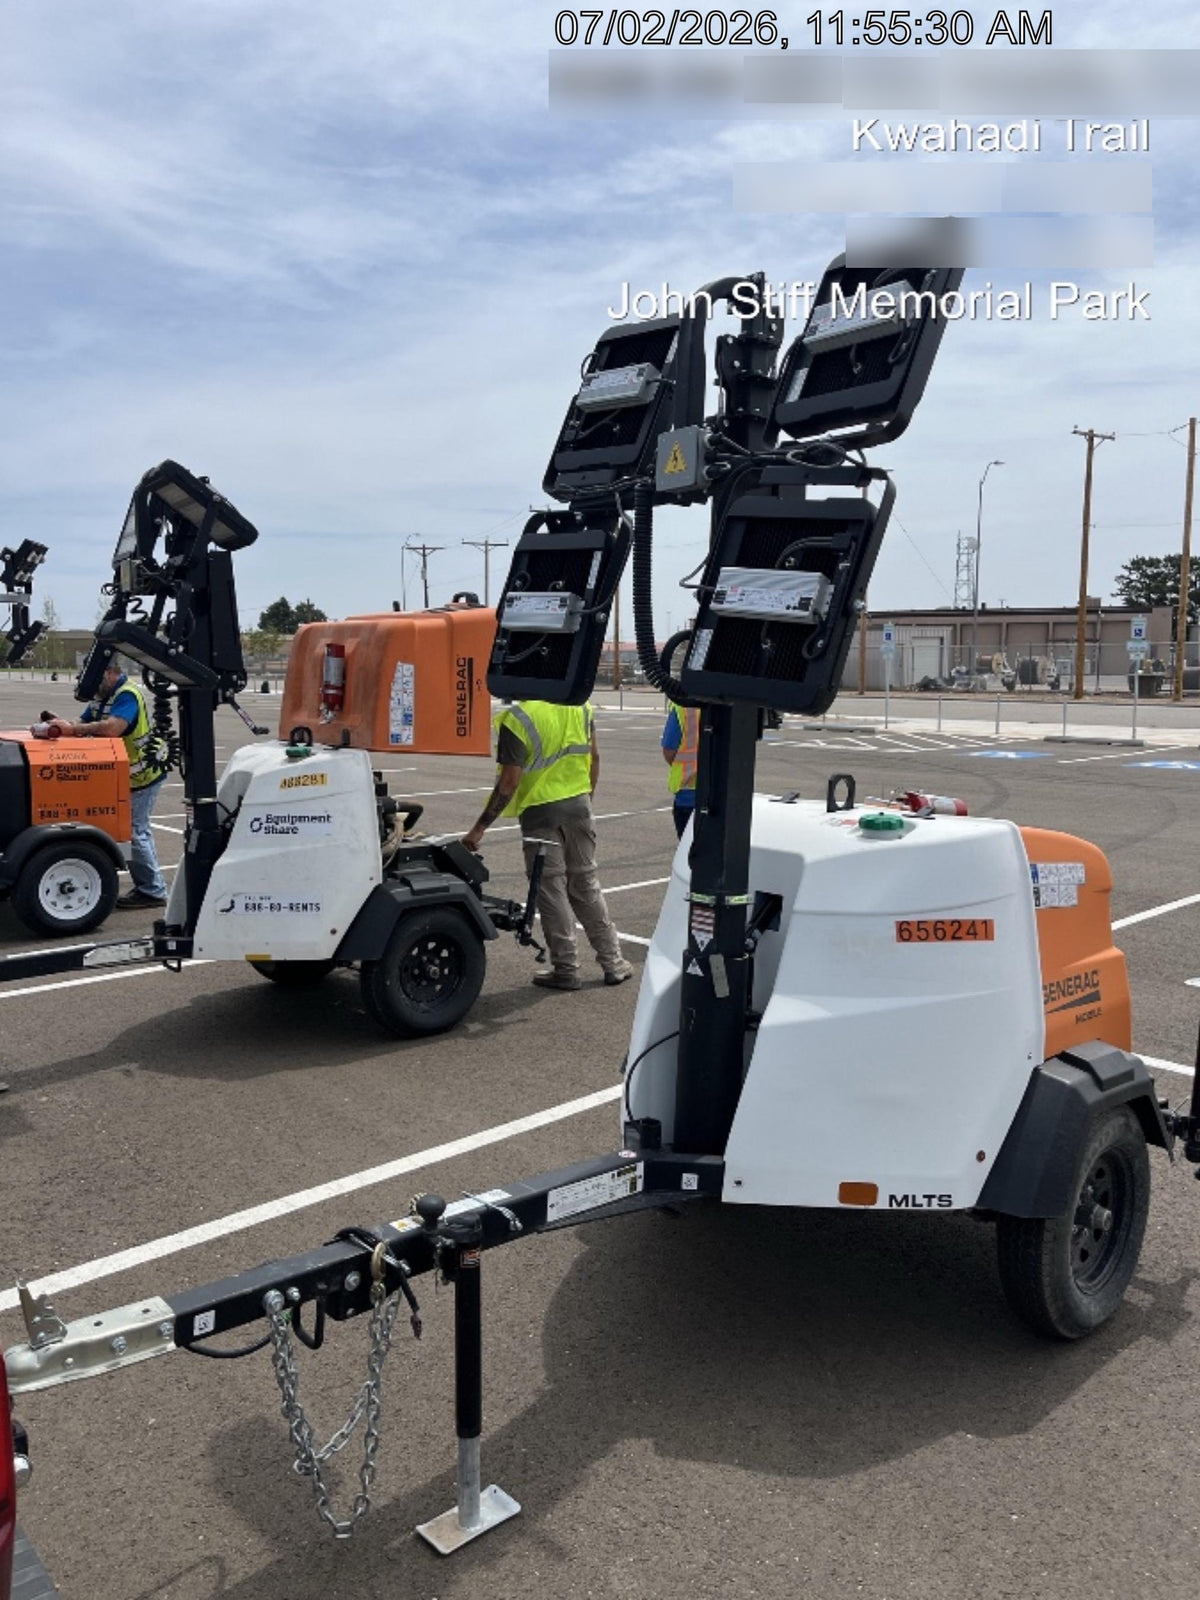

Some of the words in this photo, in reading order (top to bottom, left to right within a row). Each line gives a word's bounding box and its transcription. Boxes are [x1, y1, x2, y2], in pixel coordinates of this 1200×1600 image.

[456, 657, 467, 737] GENERAC
[265, 813, 332, 825] Equipment
[264, 824, 299, 835] Share
[898, 919, 990, 942] 656241
[888, 1194, 953, 1208] MLTS
